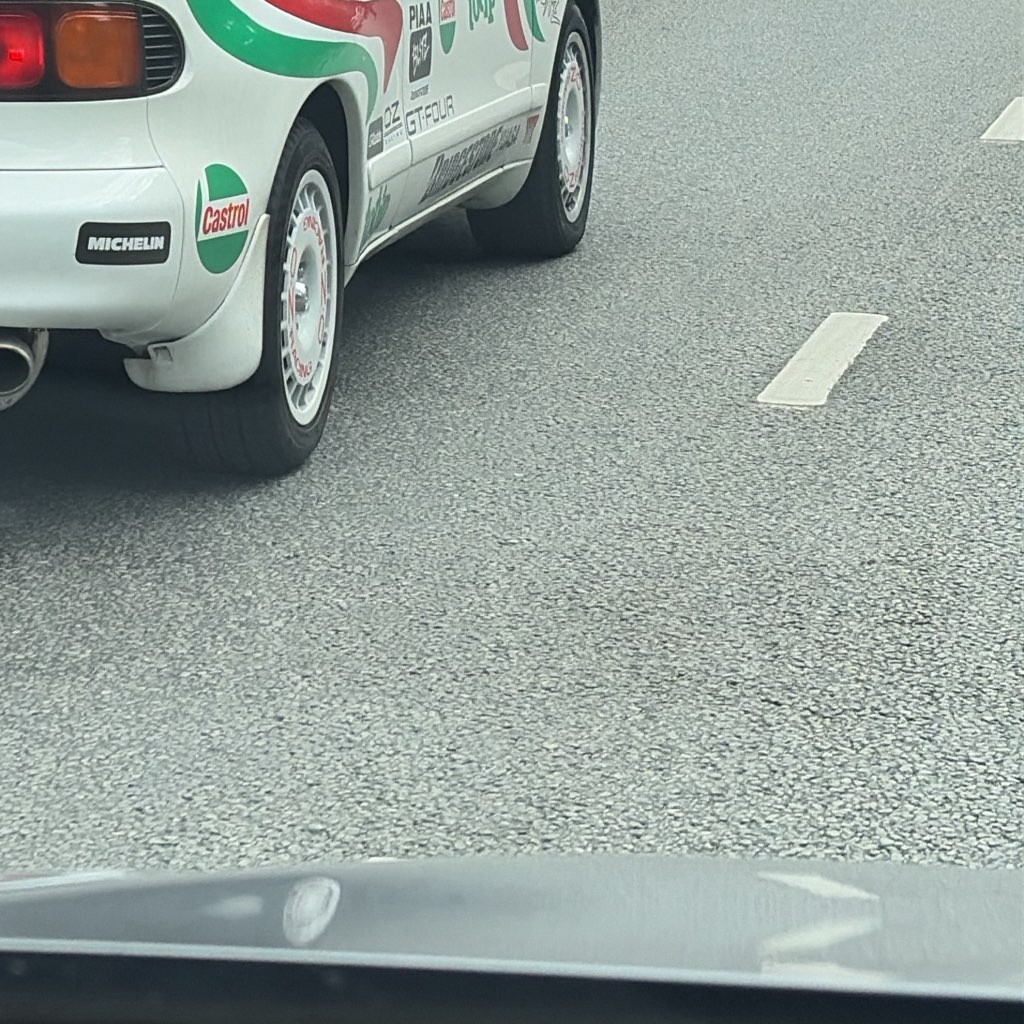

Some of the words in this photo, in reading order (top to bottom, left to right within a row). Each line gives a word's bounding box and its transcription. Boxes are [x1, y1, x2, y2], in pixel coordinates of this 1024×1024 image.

[409, 2, 432, 30] PIAA
[384, 101, 401, 129] OZ
[202, 198, 250, 236] Castrol
[87, 235, 164, 252] MICHELIN
